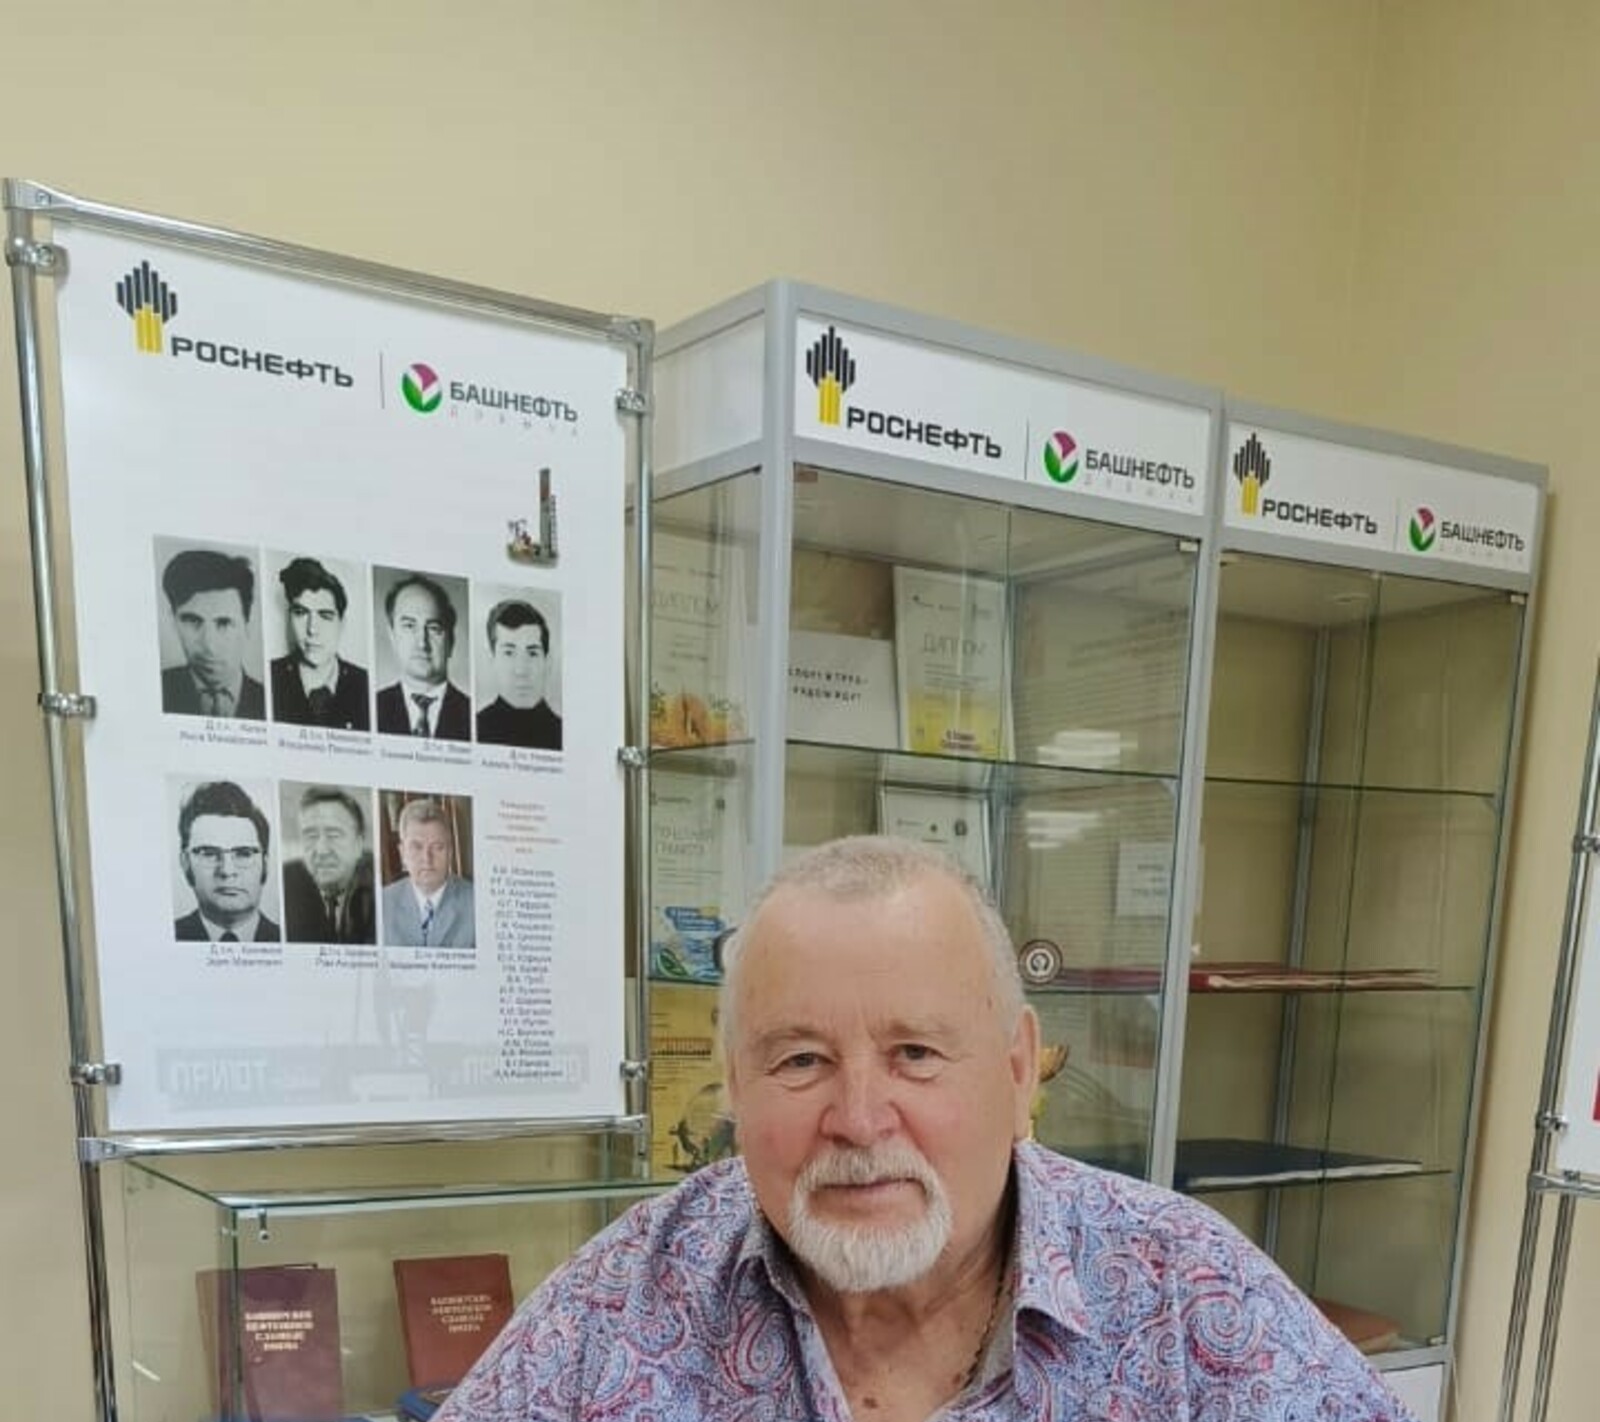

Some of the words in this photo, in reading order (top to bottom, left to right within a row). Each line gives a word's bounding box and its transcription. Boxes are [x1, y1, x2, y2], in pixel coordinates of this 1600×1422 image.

[171, 336, 354, 387] РОСНЕФТЬ
[450, 381, 578, 423] БАШНЕФТЬ
[847, 406, 1002, 459] РОСНЕФТЬ
[1085, 450, 1195, 490] БАШНЕФТЬ
[1262, 498, 1377, 534] РОСНЕФТЬ
[1440, 522, 1525, 552] БАШНЕФТЬ
